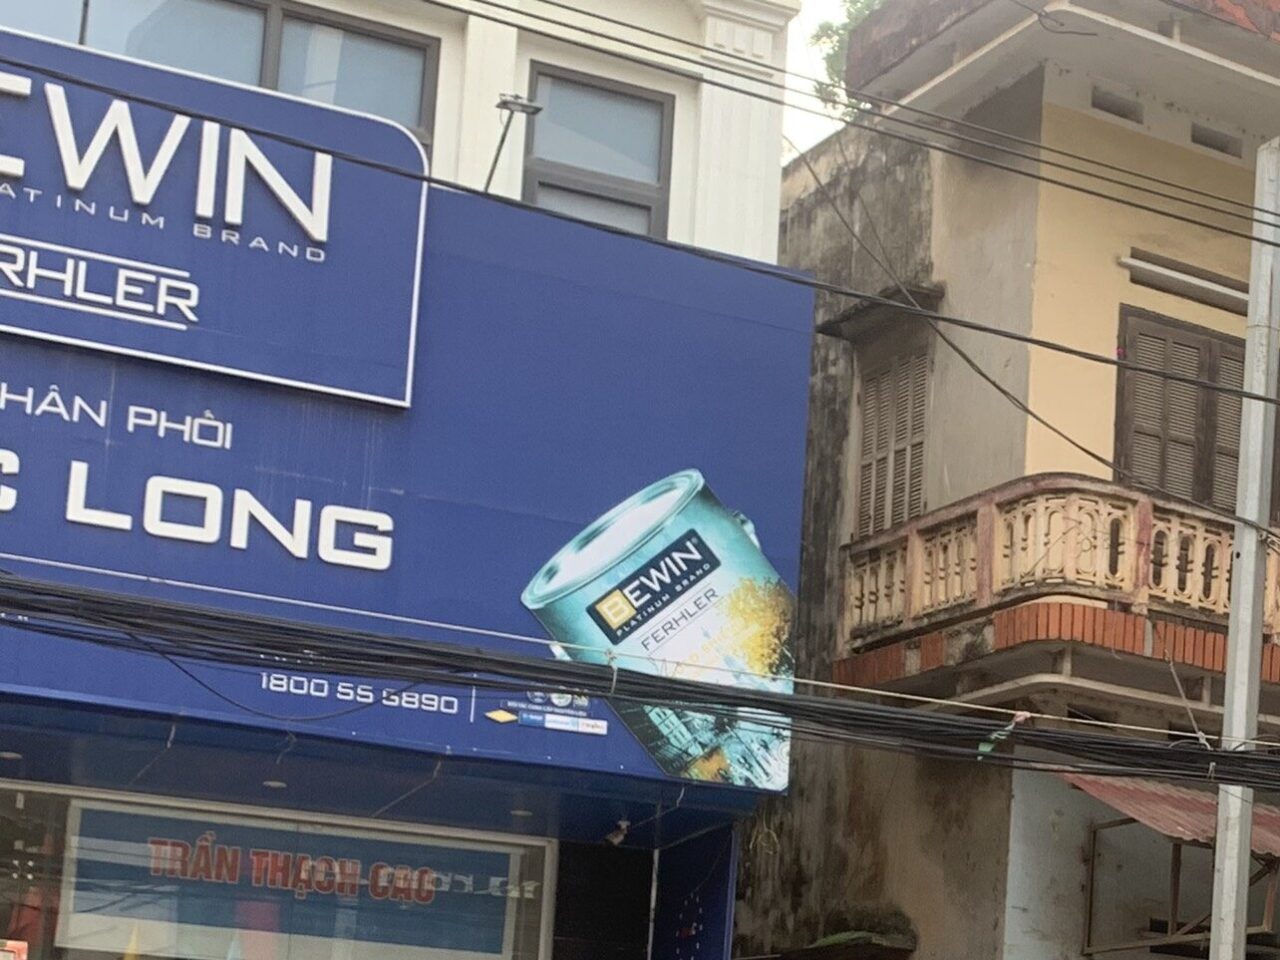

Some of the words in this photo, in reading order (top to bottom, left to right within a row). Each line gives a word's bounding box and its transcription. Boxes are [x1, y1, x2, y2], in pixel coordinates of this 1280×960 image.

[193, 223, 326, 263] BRAND
[66, 459, 394, 572] LONG
[600, 540, 703, 623] BEWIN
[616, 593, 671, 637] PLATINUM
[674, 562, 711, 593] BRAND
[640, 587, 719, 652] FERHLER
[260, 671, 329, 698] 1800
[336, 682, 374, 704] 55
[382, 687, 459, 714] 5890
